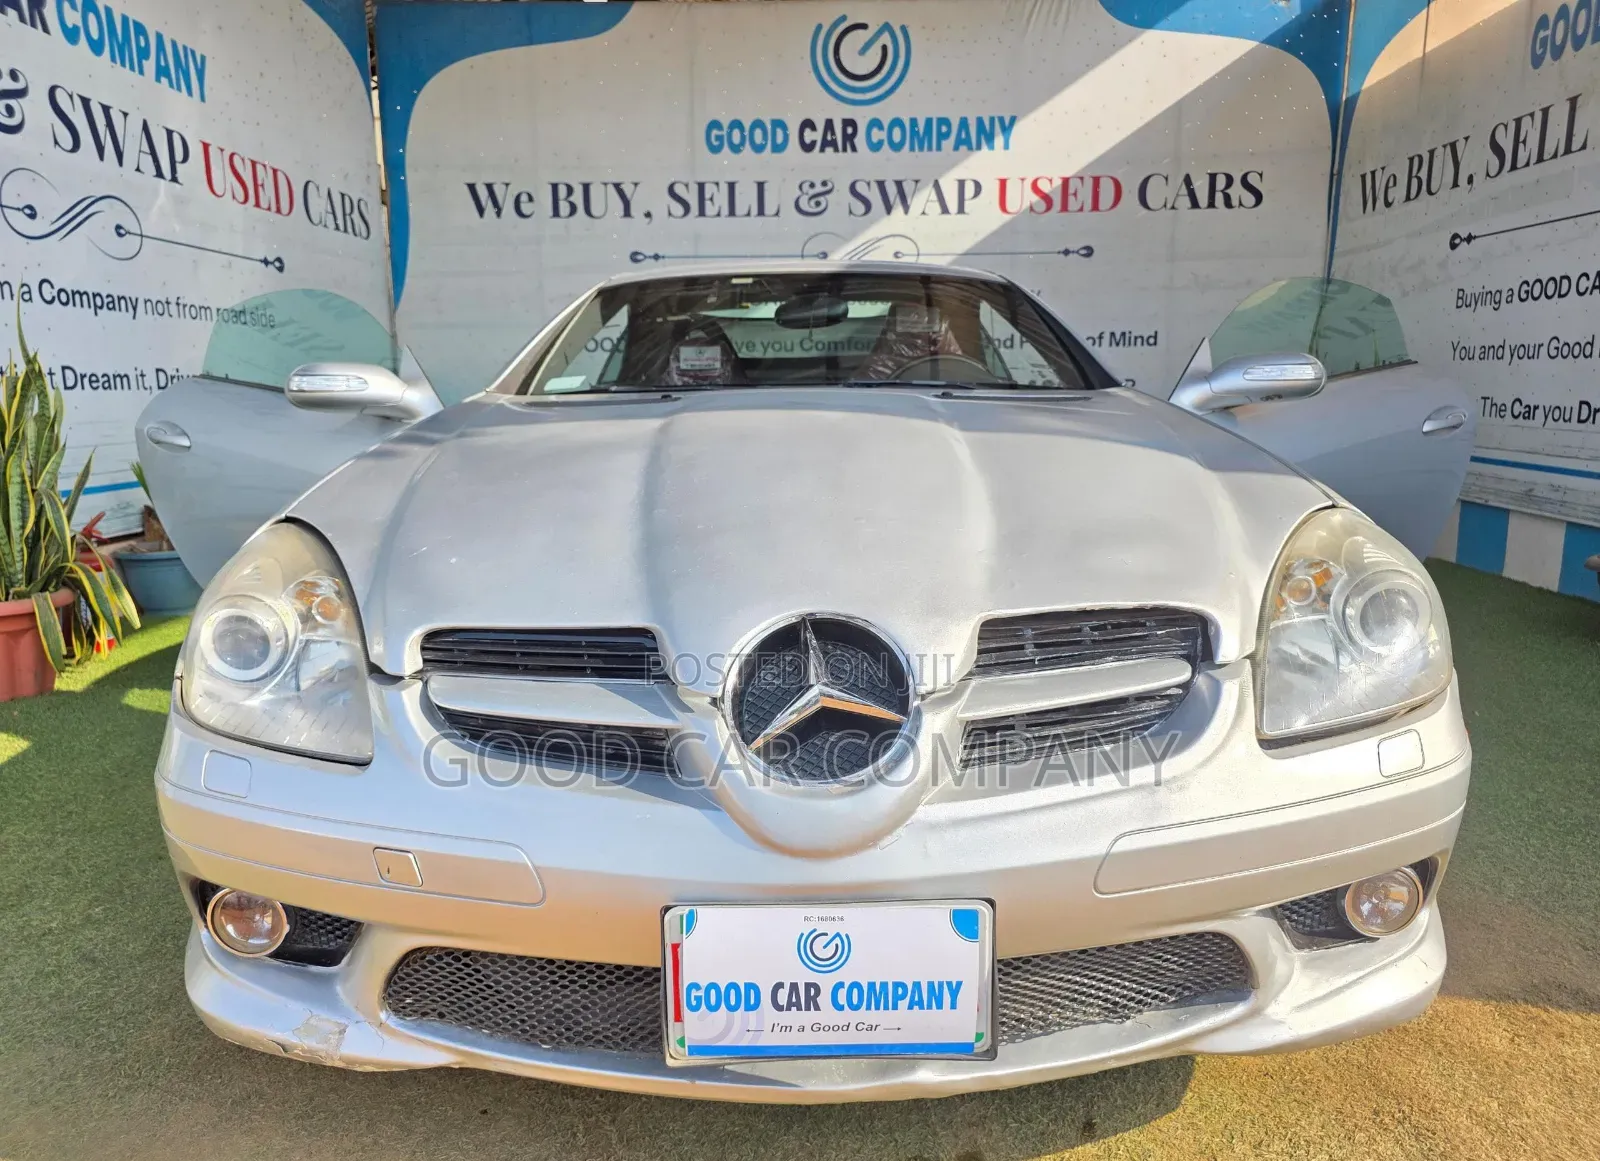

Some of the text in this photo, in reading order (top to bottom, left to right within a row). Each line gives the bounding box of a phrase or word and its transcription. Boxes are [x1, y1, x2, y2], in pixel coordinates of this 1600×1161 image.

[56, 0, 207, 103] COMPANY
[705, 115, 1017, 155] GOOD CAR COMPANY
[1359, 93, 1589, 215] We BUY, SELL
[48, 84, 191, 186] SWAP
[200, 140, 295, 217] USED
[303, 180, 371, 240] CARS
[466, 170, 1264, 225] We BUY, SELL & SWAP USED CARS
[38, 278, 139, 320] Company
[143, 297, 173, 319] not
[175, 296, 214, 323] from
[216, 303, 248, 326] road
[249, 305, 277, 329] side
[1455, 286, 1502, 313] Buying
[1505, 287, 1514, 304] a
[1517, 274, 1572, 303] GOOD
[761, 341, 793, 355] you
[800, 337, 878, 352] Comfor
[1109, 330, 1158, 348] Mind
[1451, 334, 1595, 366] You and your Good
[61, 365, 131, 391] Dream
[134, 367, 154, 396] it,
[155, 367, 197, 392] Dri
[1481, 396, 1507, 418] The
[1510, 397, 1539, 420] Car
[1542, 404, 1573, 428] you
[686, 980, 963, 1012] GOOD CAR COMPANY
[771, 1021, 881, 1033] I'm a Good Car
